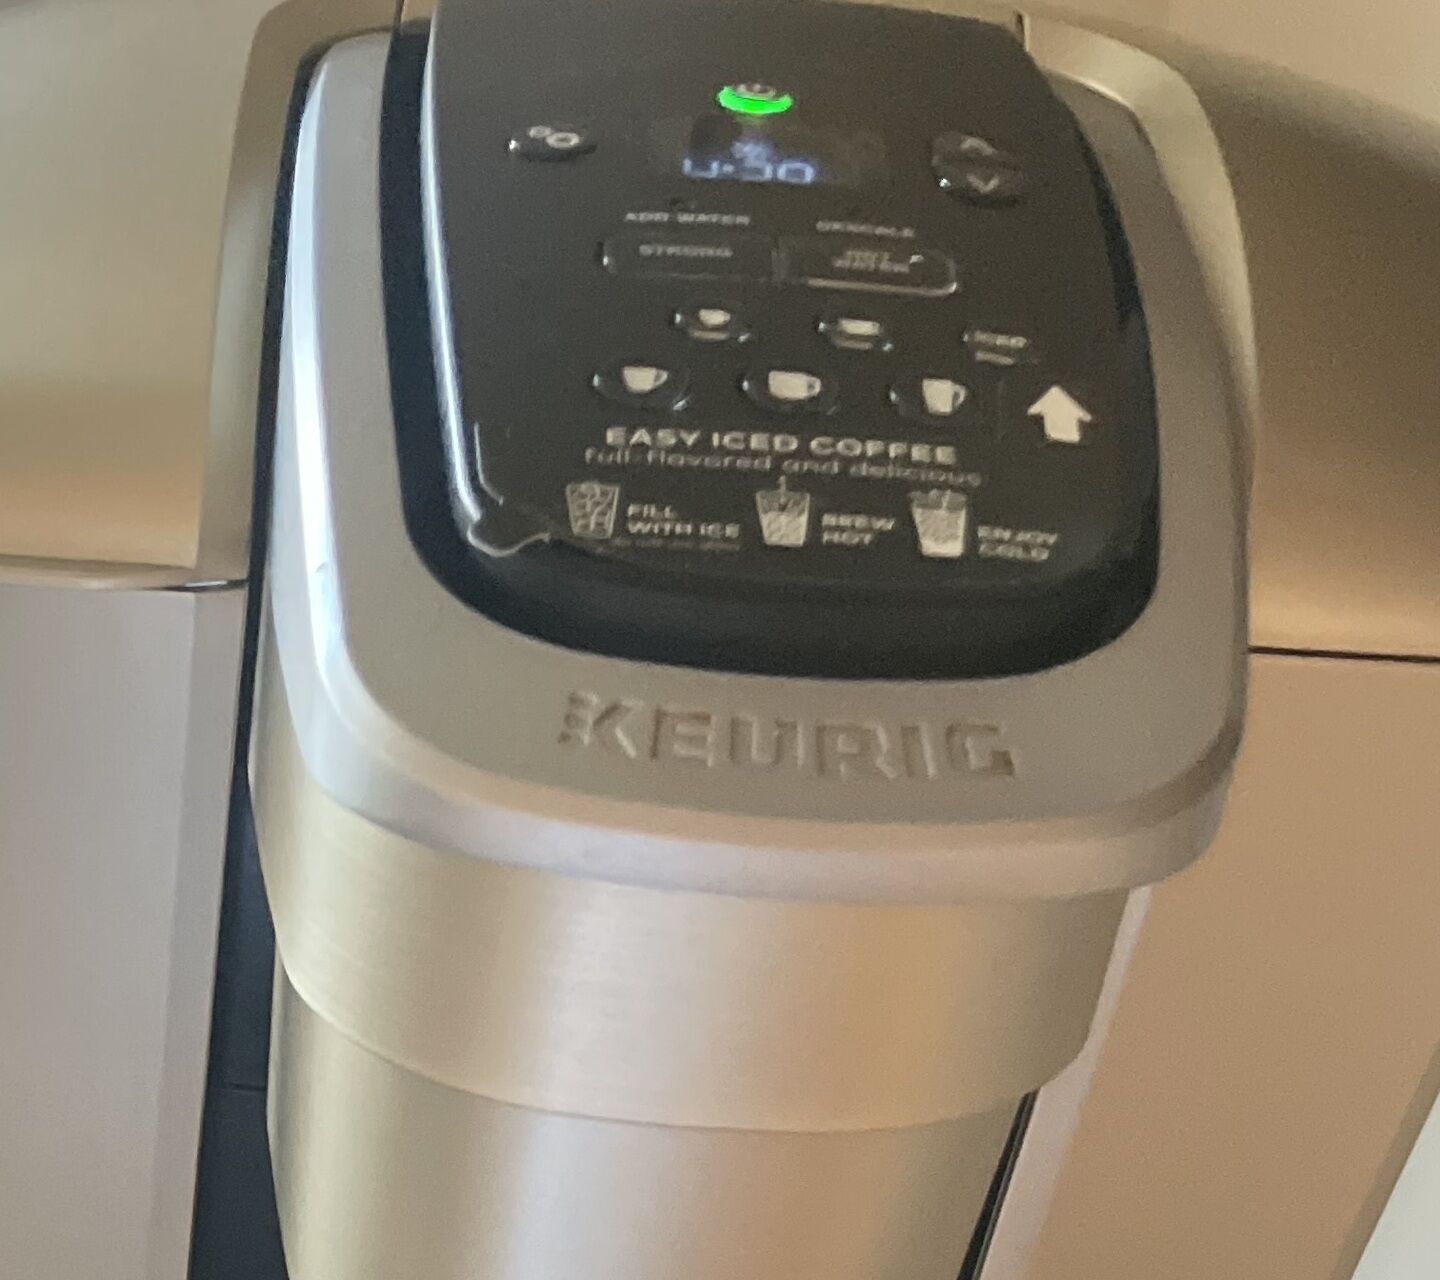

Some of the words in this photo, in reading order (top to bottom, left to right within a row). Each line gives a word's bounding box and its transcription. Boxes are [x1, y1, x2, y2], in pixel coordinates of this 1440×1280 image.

[605, 425, 702, 447] EASY
[712, 431, 799, 453] ICED
[808, 436, 957, 466] COFFEE
[627, 520, 693, 535] WITH
[557, 690, 1016, 780] KEURIG
